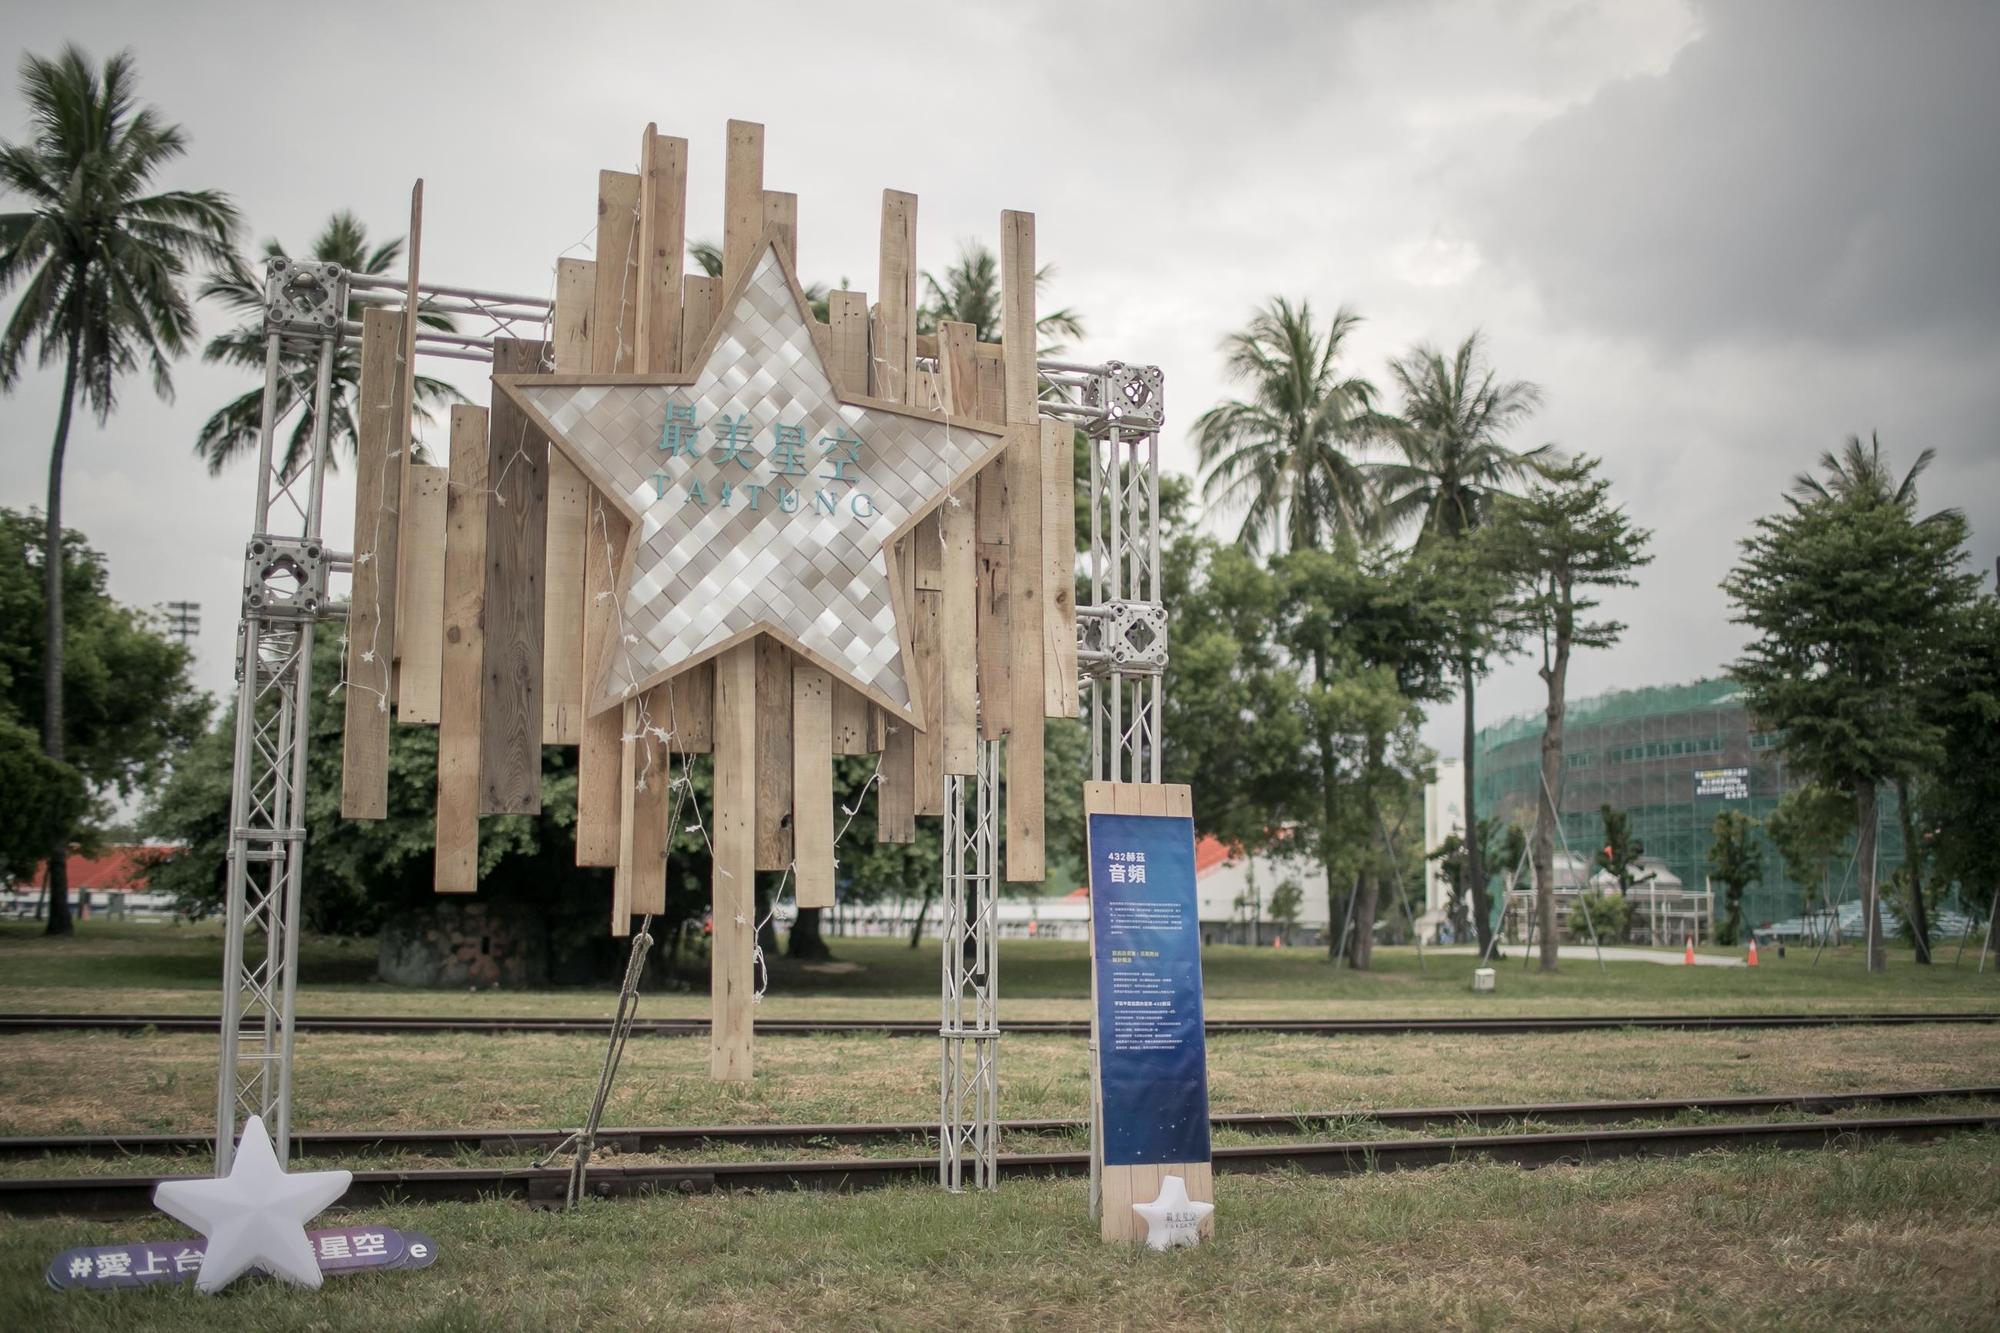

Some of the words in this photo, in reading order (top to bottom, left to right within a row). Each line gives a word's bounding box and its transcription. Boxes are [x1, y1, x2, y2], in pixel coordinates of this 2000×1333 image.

[659, 400, 864, 484] 最美星空
[653, 474, 874, 518] TAITUNG
[1108, 863, 1147, 884] 音頻
[310, 1233, 388, 1260] 星空
